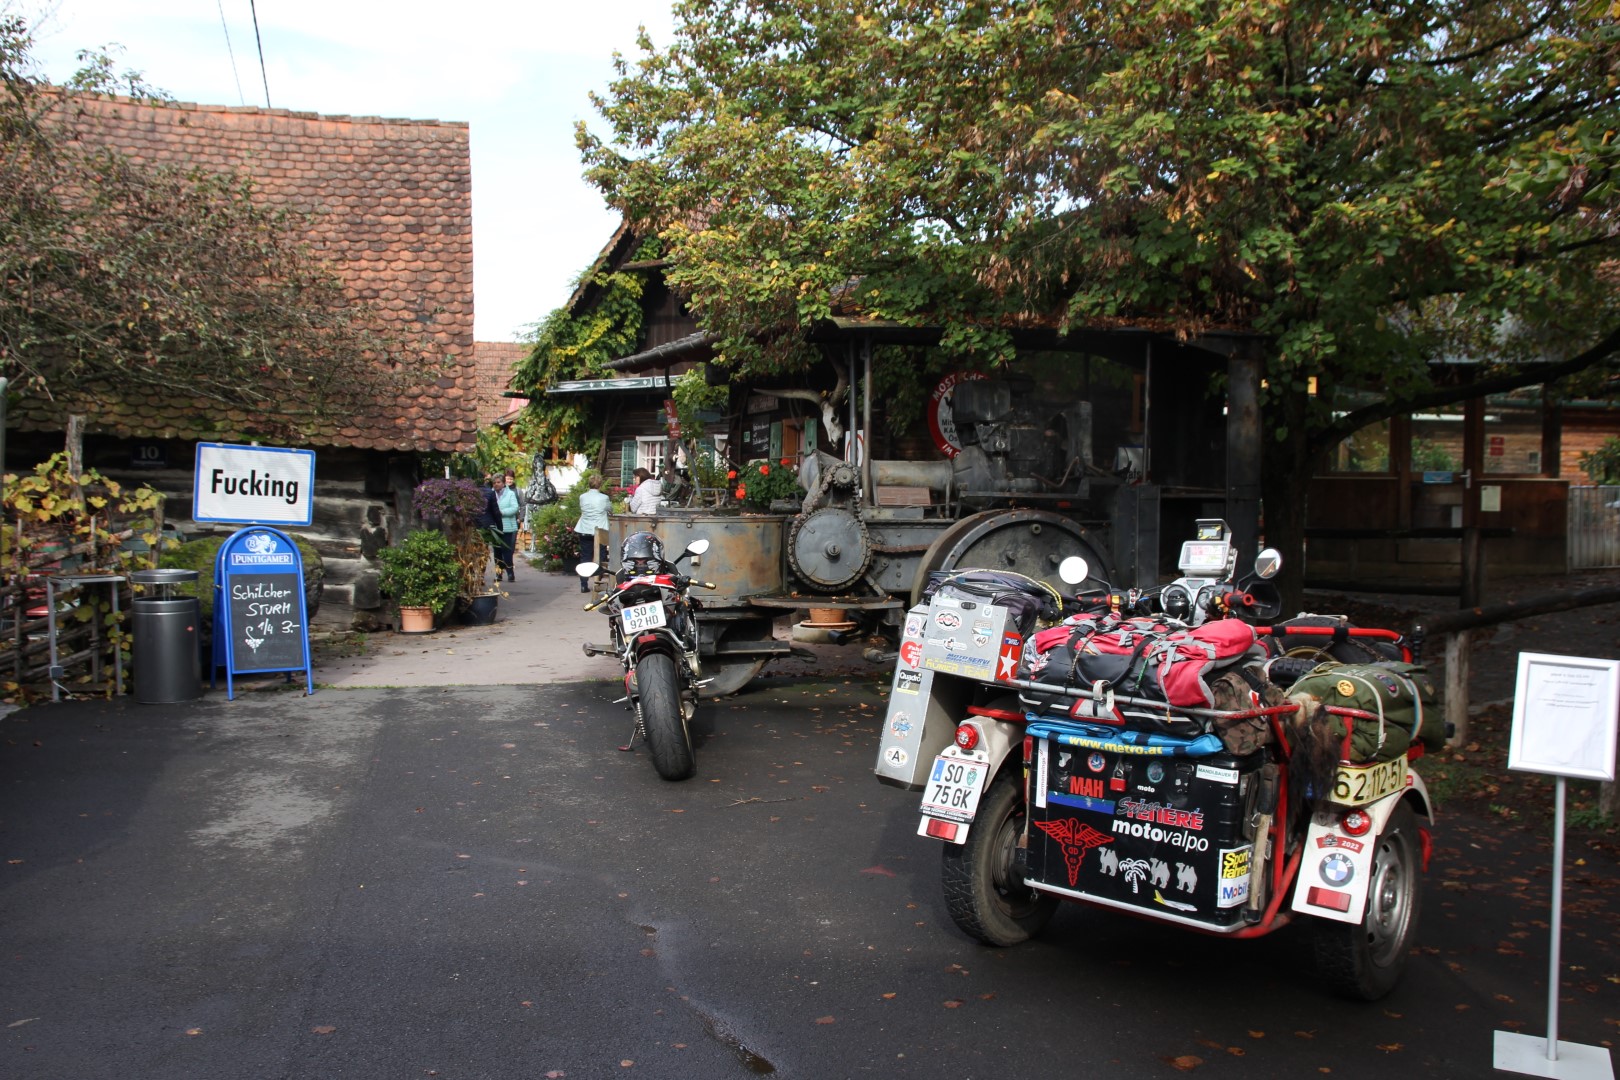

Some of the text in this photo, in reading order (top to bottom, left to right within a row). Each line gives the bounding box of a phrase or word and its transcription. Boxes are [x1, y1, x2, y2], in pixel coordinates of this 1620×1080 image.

[140, 446, 159, 460] 10
[211, 468, 299, 505] Fucking
[235, 555, 290, 564] PUNTIGAMER
[246, 602, 291, 617] STURM
[633, 606, 647, 618] SO
[257, 618, 274, 635] 1/4
[630, 615, 659, 630] 92 HD
[976, 635, 986, 644] 40
[899, 671, 921, 682] Quadro
[1069, 736, 1163, 755] www.metro.at
[891, 750, 900, 762] A
[944, 764, 965, 784] SO
[1069, 775, 1105, 799] MAH
[1137, 785, 1156, 793] moto
[932, 784, 972, 809] 75 GK
[1112, 819, 1209, 853] motovalpo
[1341, 840, 1360, 850] 2022
[1223, 849, 1249, 867] Sport
[1324, 853, 1353, 868] BMW
[1223, 882, 1248, 899] Mobil
